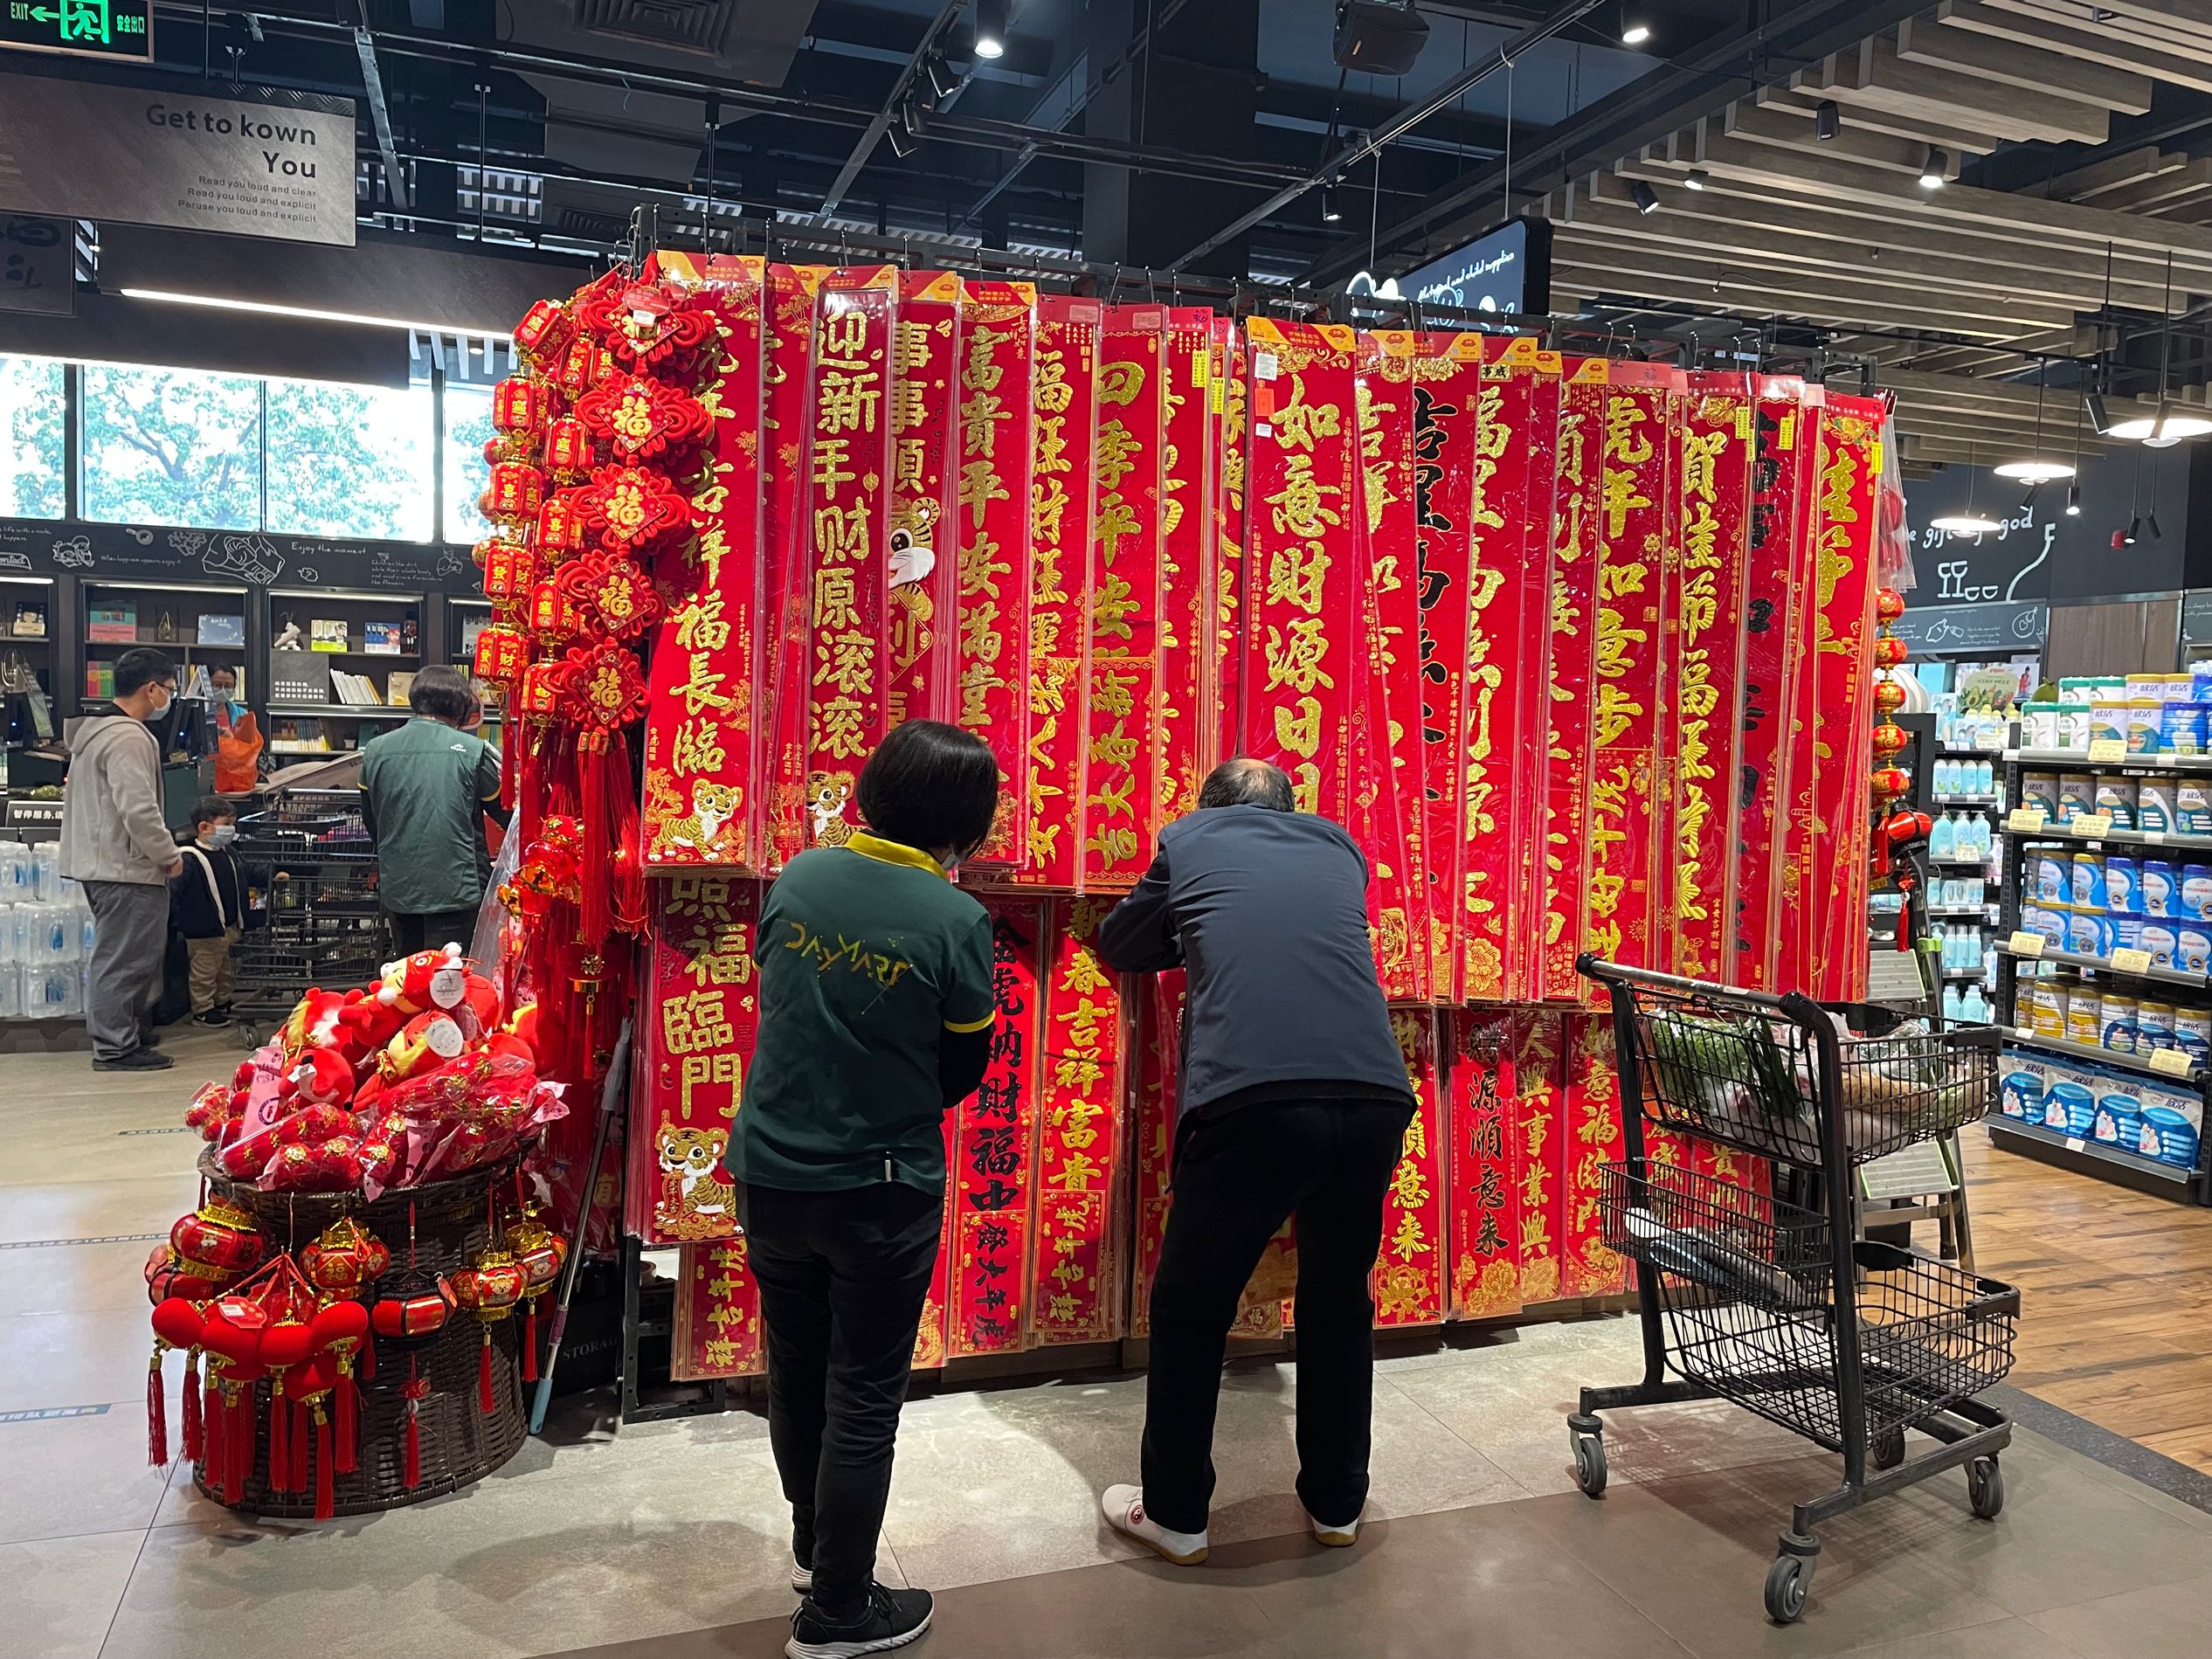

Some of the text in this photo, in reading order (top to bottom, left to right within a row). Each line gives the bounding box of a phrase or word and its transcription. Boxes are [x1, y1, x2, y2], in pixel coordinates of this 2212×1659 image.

[10, 2, 29, 20] EXIT
[116, 15, 145, 34] 安全出口
[146, 104, 316, 145] Get to kown
[262, 150, 316, 178] You
[188, 187, 316, 211] Read you loud and explicit
[199, 176, 316, 197] Read you loud and clear
[178, 199, 316, 224] Peruse you loud and explicit
[606, 485, 646, 525] 福
[1090, 362, 1146, 657] 四季平安
[1997, 505, 2033, 542] god
[291, 541, 367, 556] Enjoy the moment
[598, 575, 634, 618] 福
[589, 666, 623, 707] 福
